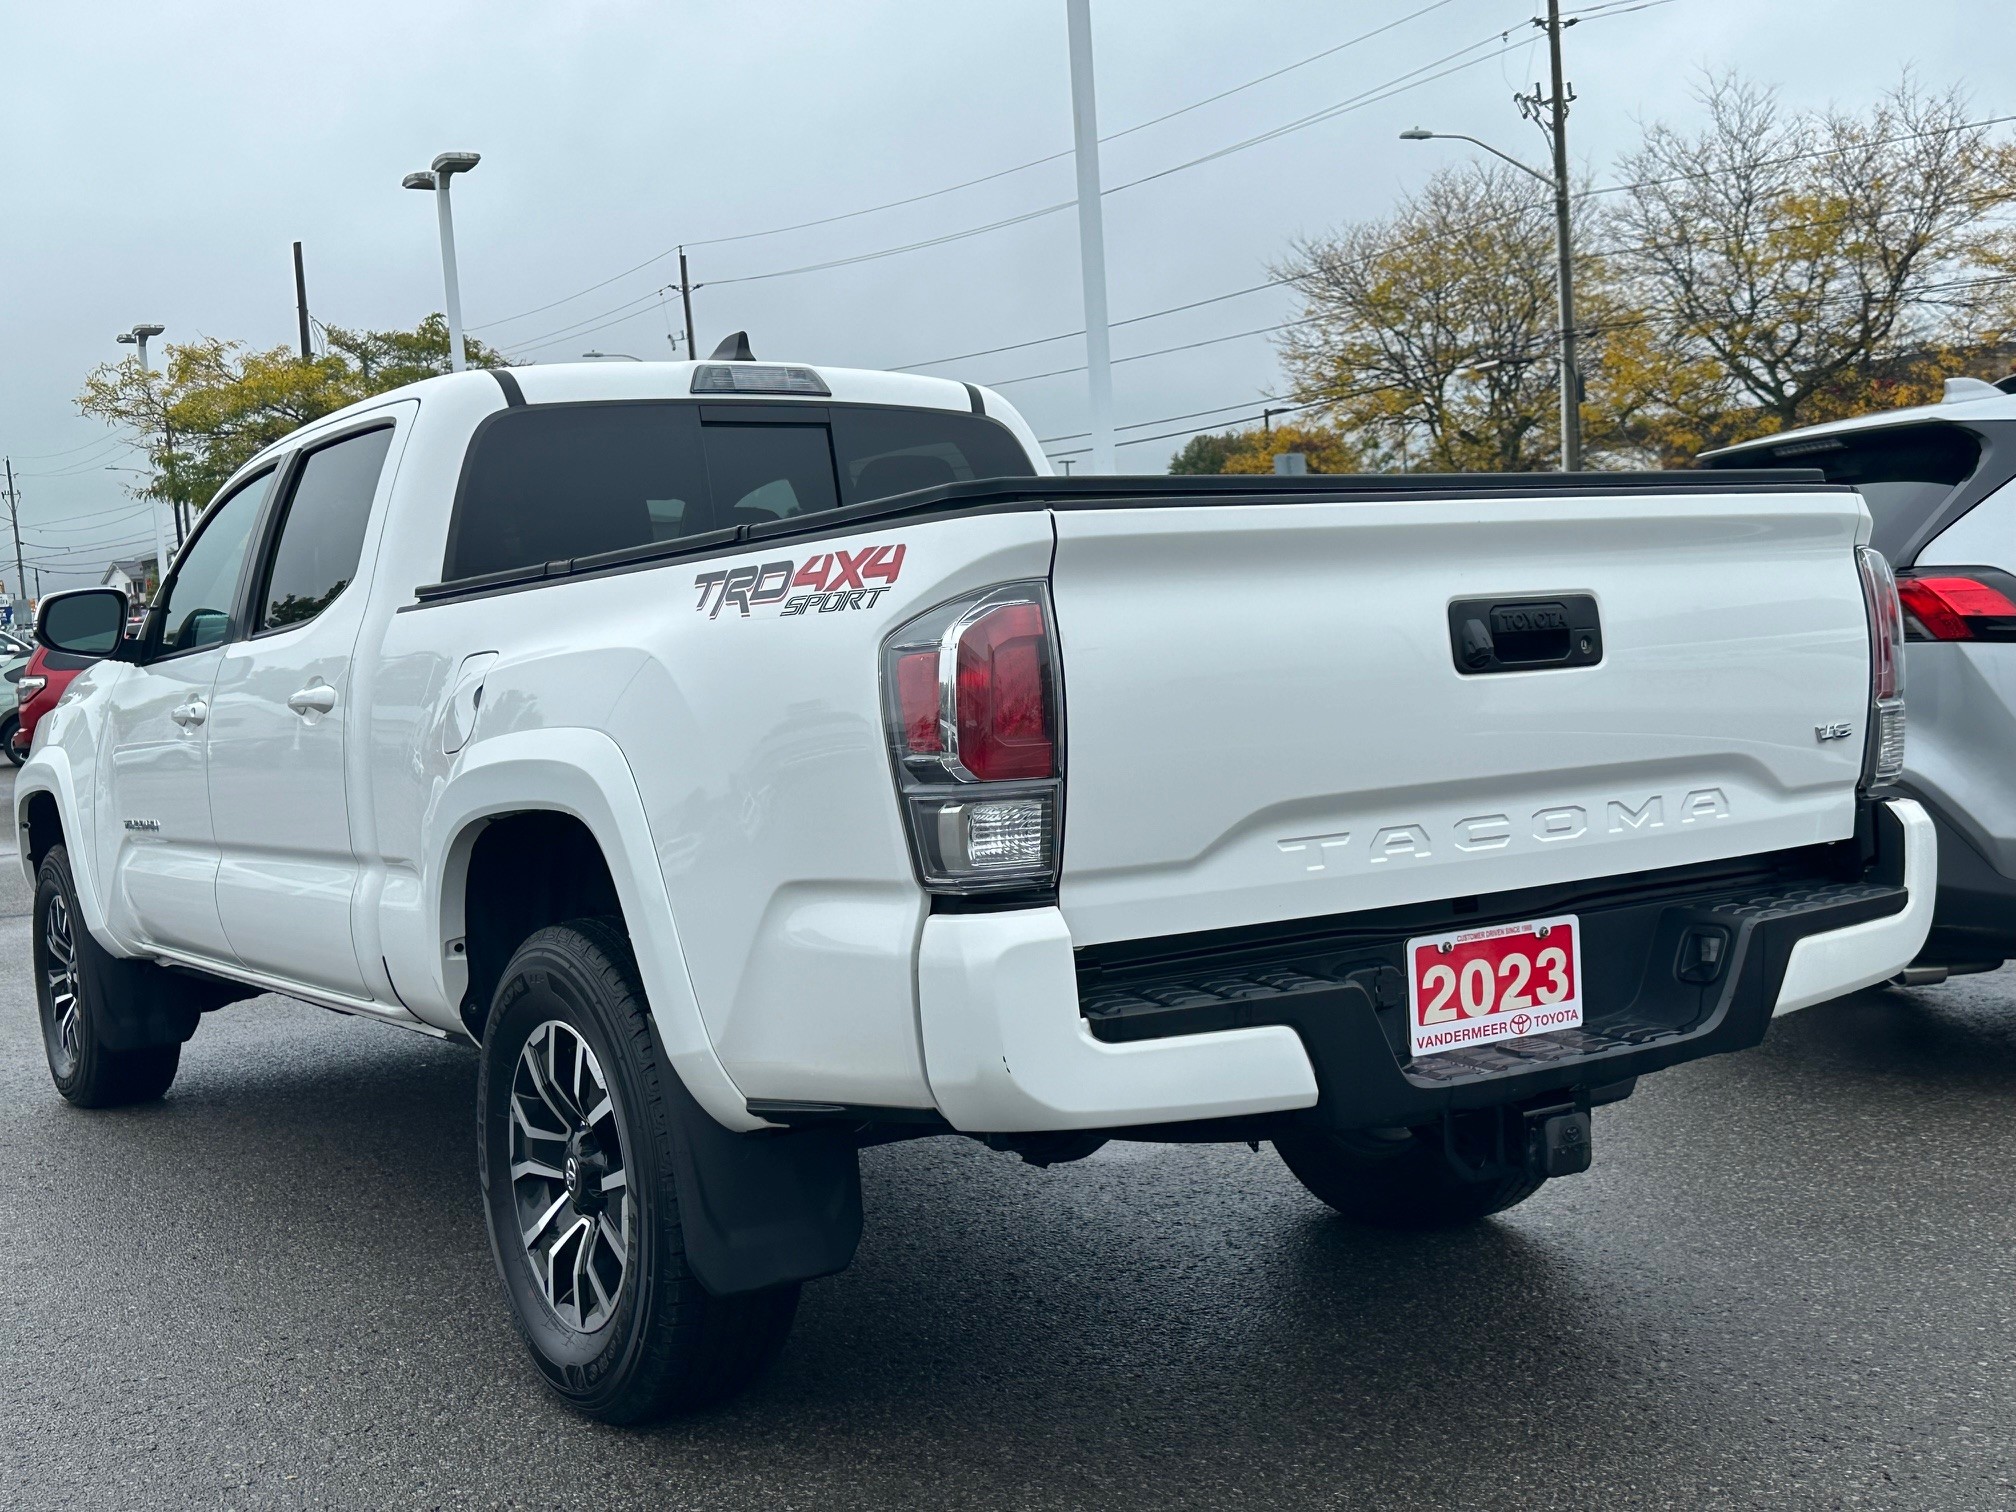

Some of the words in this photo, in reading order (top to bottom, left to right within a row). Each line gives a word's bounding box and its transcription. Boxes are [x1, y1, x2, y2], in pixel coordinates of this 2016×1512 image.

[694, 560, 795, 621] TRD
[791, 543, 907, 593] 4X4
[779, 586, 892, 617] SPORT
[1501, 610, 1569, 631] TOYOTA
[1814, 720, 1852, 744] V6
[1276, 787, 1730, 871] TACOMA
[1422, 946, 1569, 1026] 2023
[1416, 1021, 1508, 1049] VANDERMEER
[1533, 1008, 1579, 1028] TOYOTA
